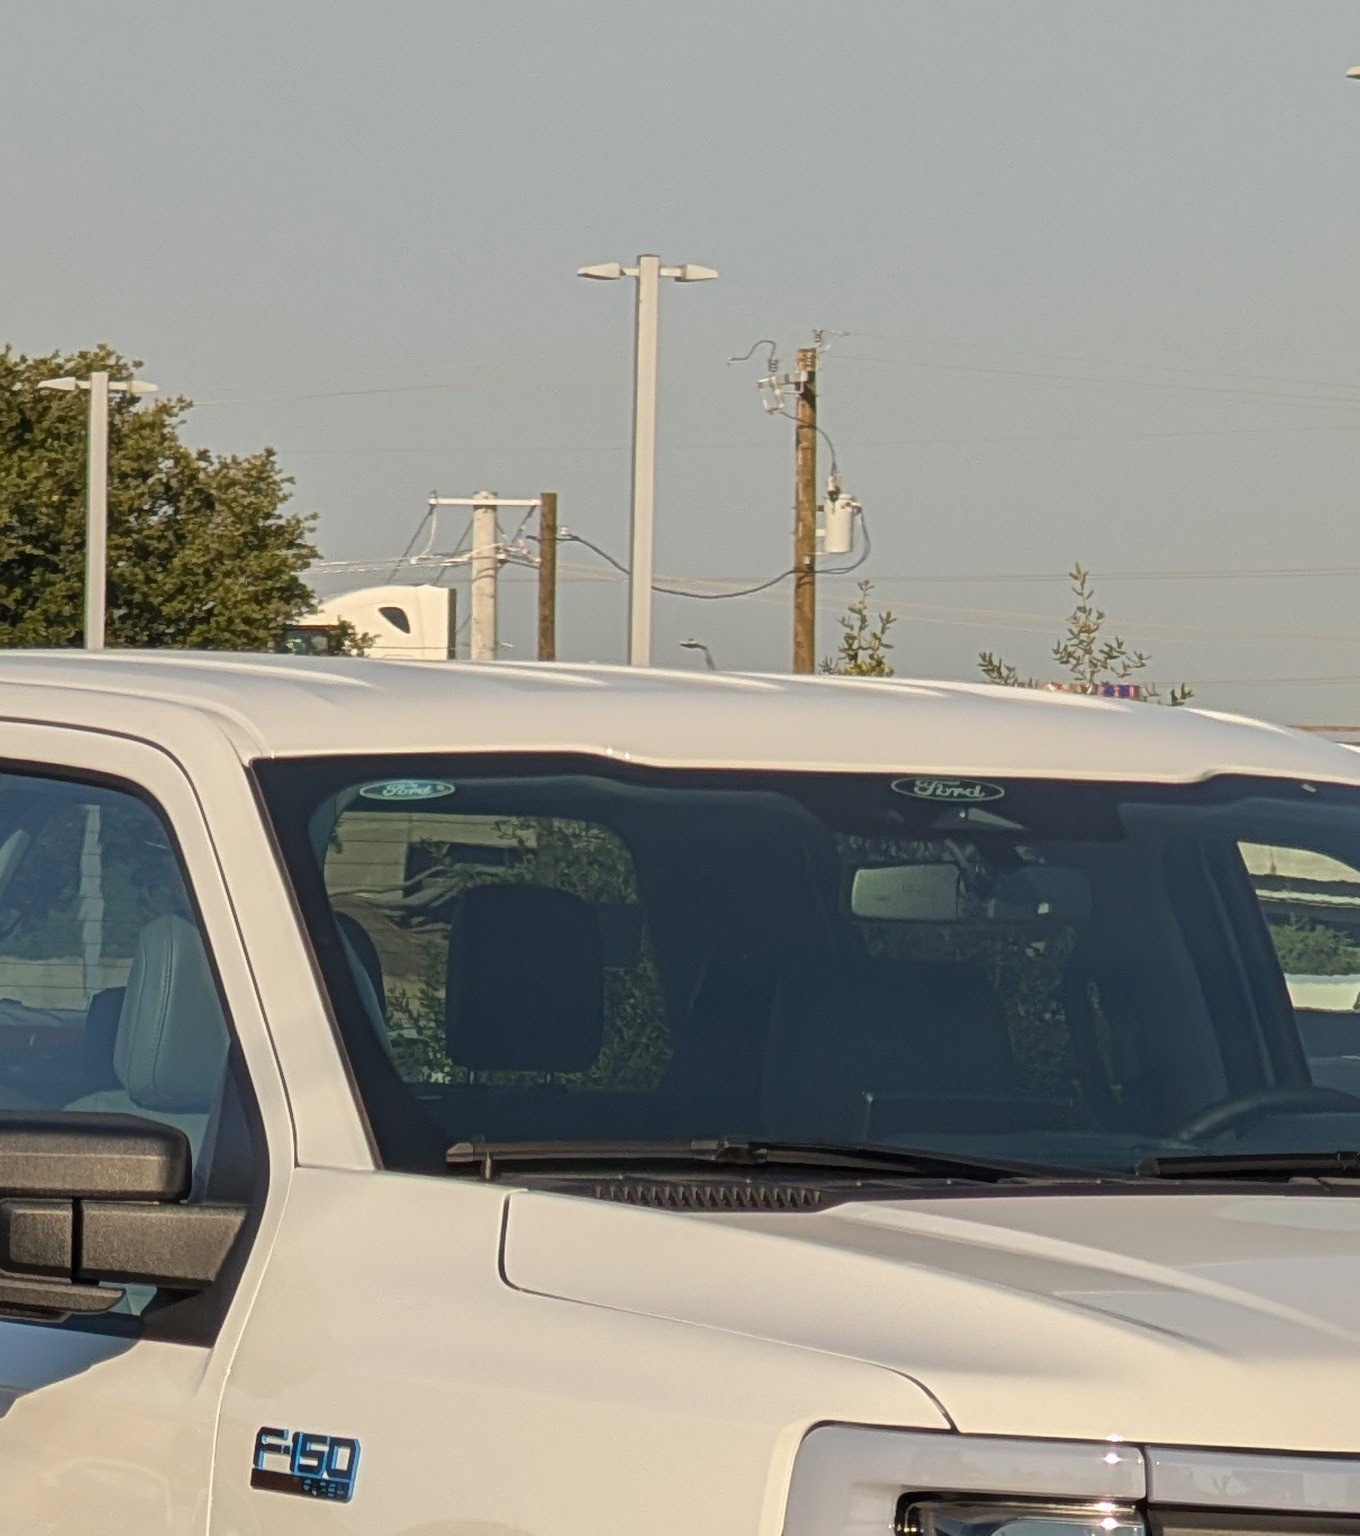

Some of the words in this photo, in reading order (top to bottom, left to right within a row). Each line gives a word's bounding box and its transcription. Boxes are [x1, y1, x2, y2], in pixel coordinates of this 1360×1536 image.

[382, 783, 433, 797] Ford
[913, 778, 986, 799] Ford
[253, 1426, 361, 1482] F-150
